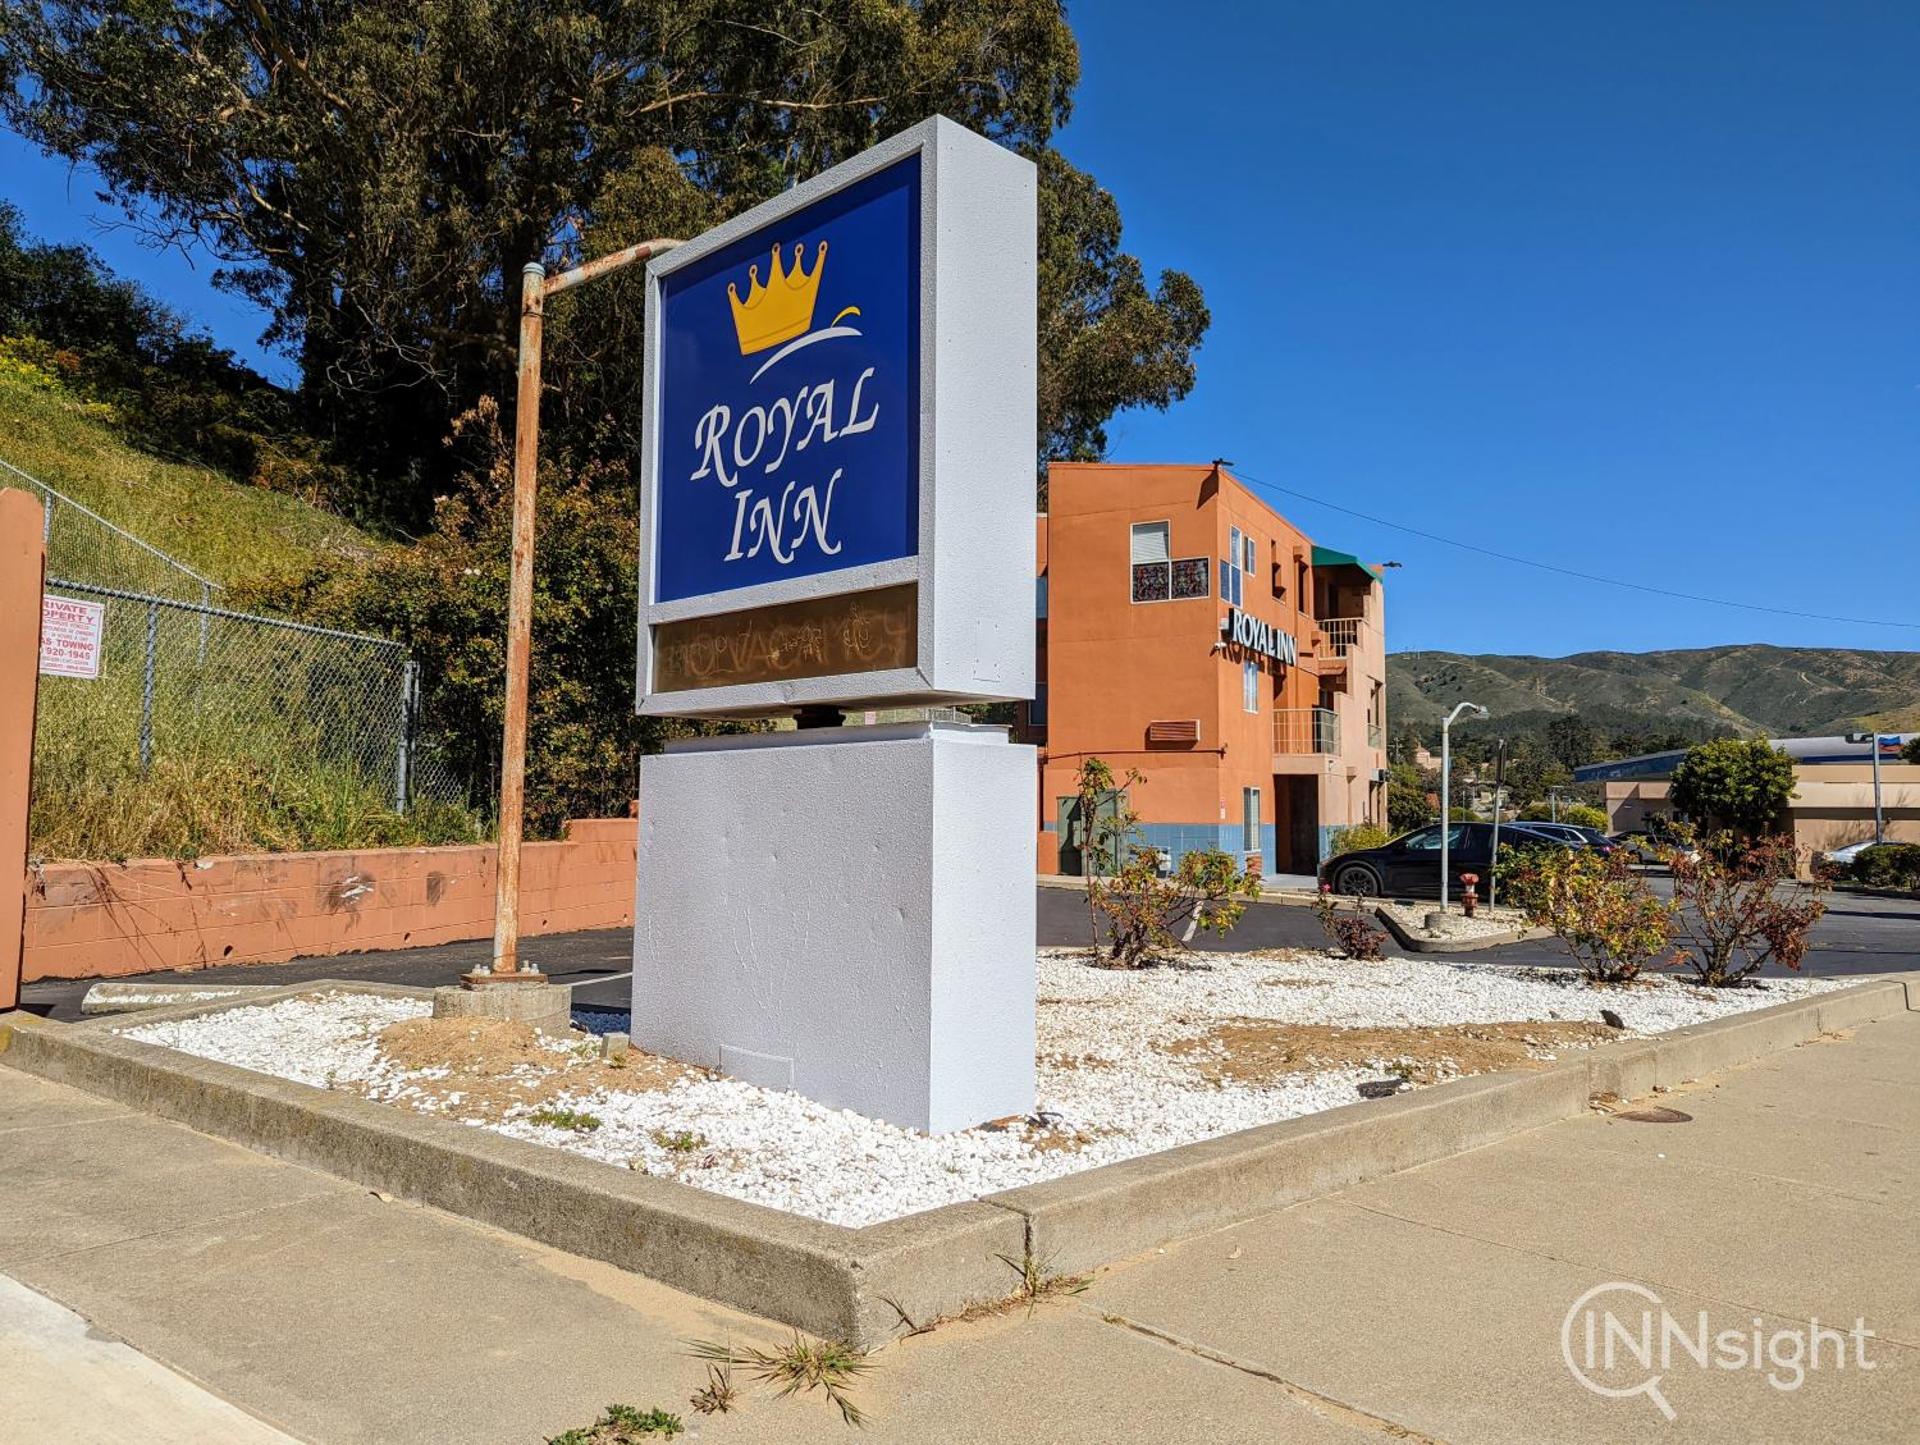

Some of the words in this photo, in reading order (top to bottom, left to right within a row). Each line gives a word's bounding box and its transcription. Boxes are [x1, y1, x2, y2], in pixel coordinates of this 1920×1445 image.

[690, 367, 880, 487] ROYAL
[723, 468, 842, 564] INN
[43, 600, 88, 615] RIVATE
[43, 610, 95, 625] OPERTY
[57, 639, 94, 651] TOWING
[1232, 608, 1275, 657] ROYAL
[1277, 629, 1298, 667] INN
[46, 646, 91, 660] 920-1945
